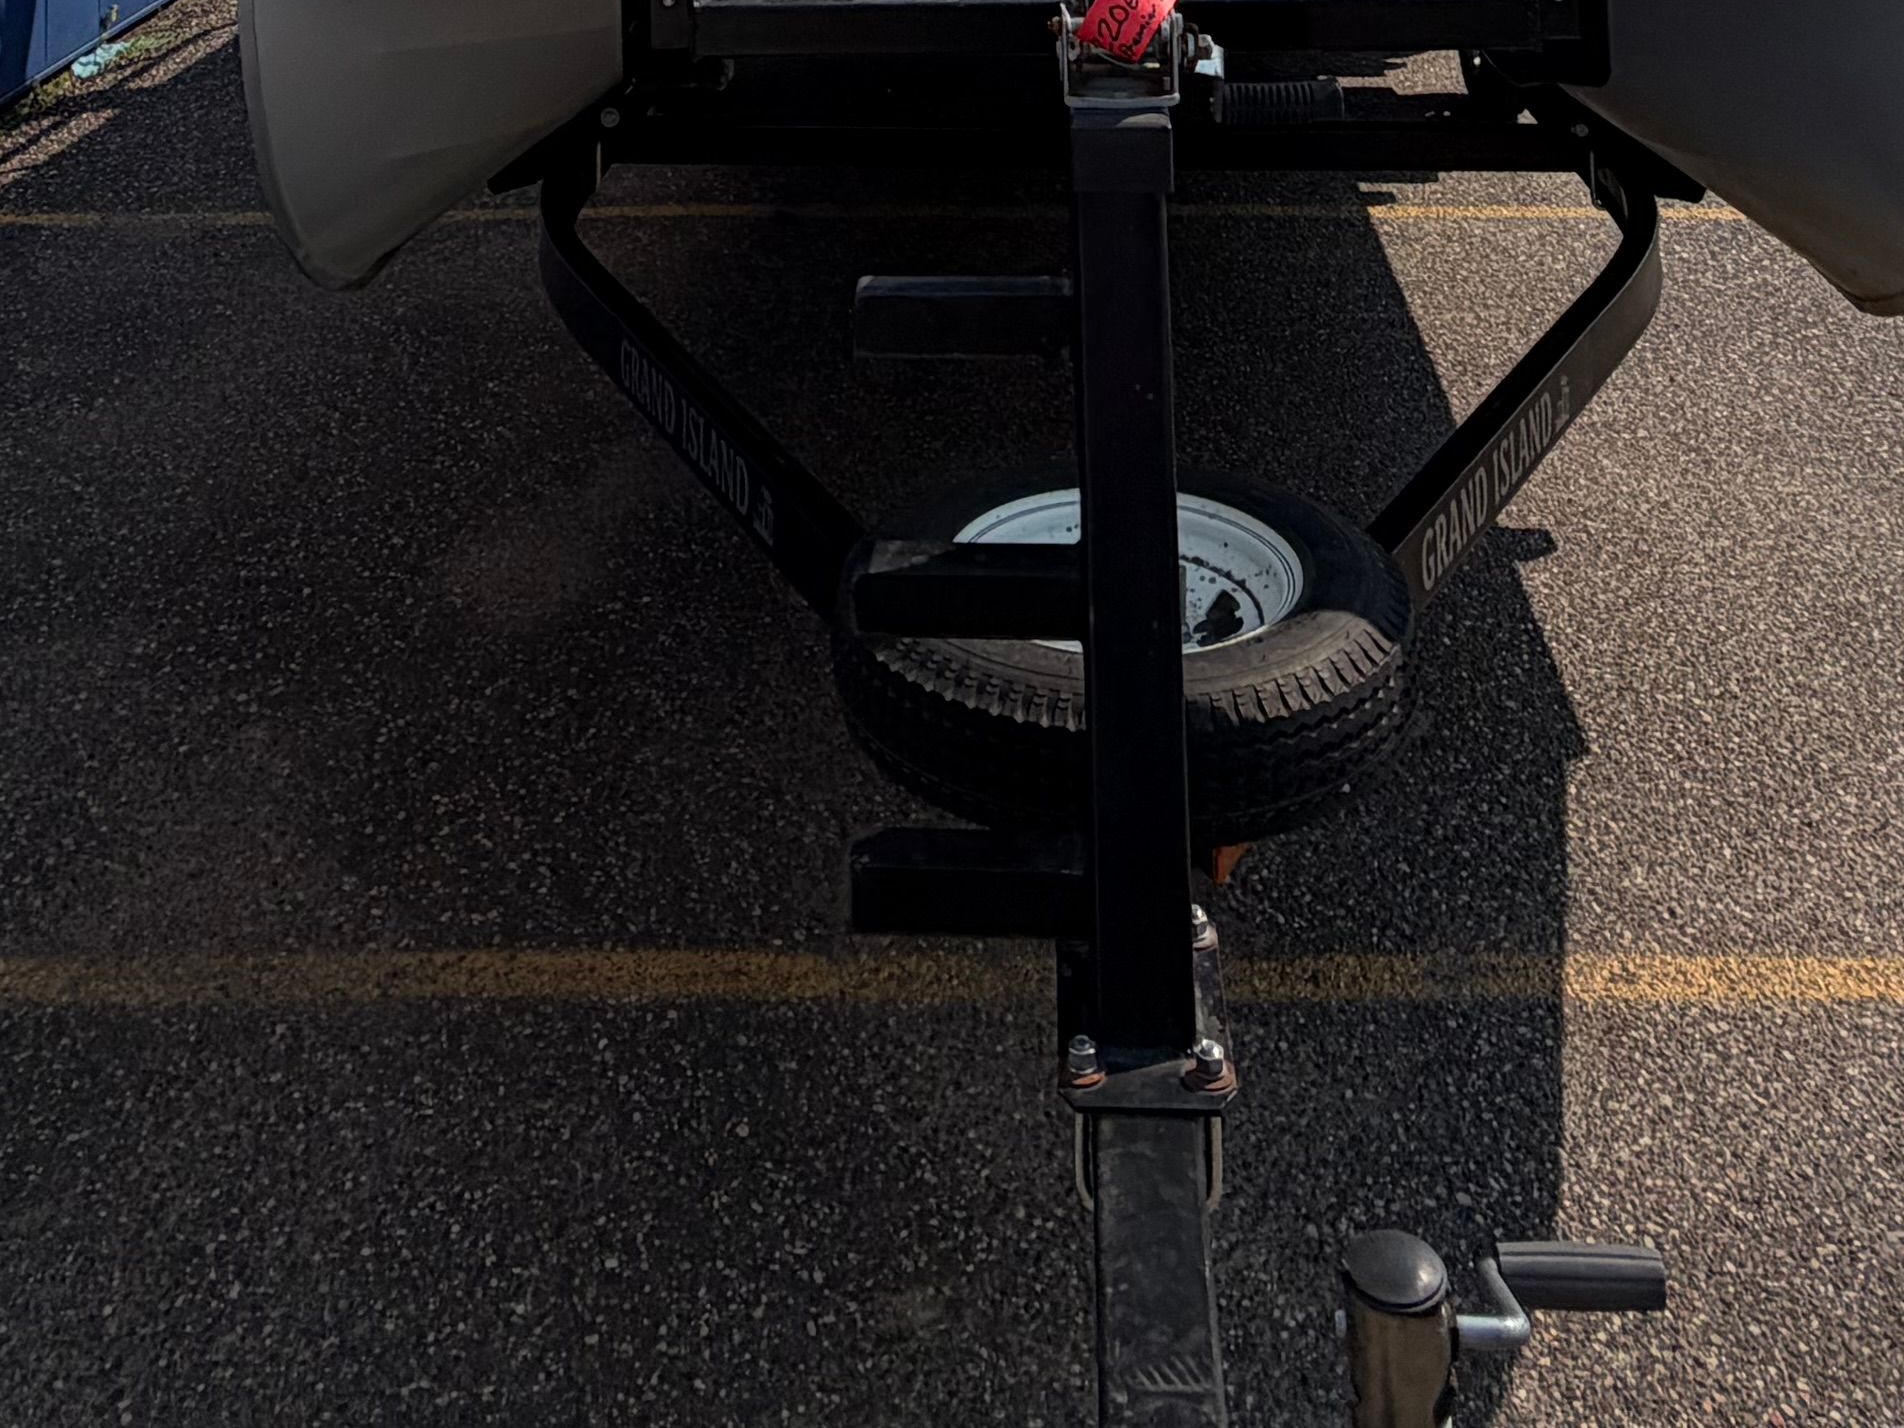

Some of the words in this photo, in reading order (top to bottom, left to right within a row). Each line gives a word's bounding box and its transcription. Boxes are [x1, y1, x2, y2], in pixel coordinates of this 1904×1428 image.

[620, 338, 676, 435] GRAND
[681, 397, 749, 516] ISLAND
[1421, 465, 1489, 592] GRAND
[1492, 391, 1553, 506] ISLAND
